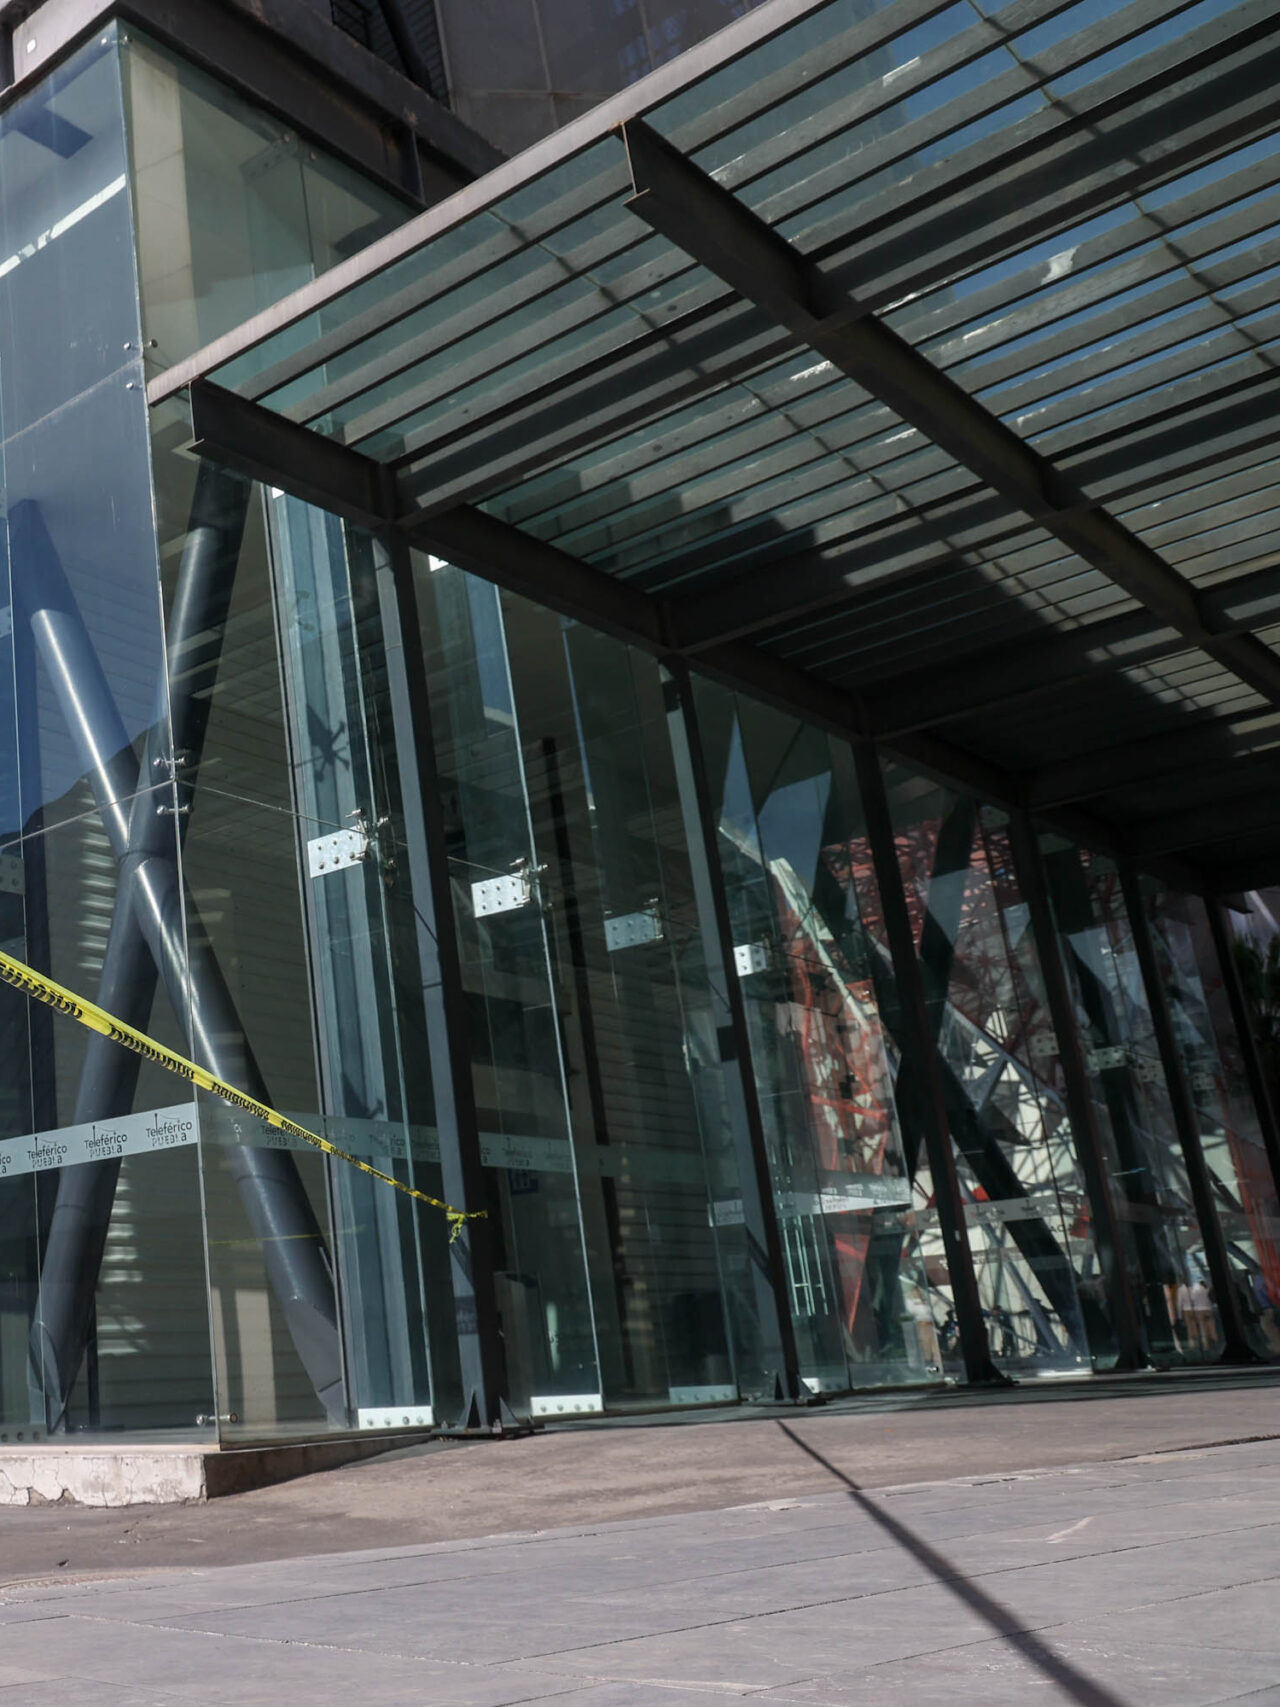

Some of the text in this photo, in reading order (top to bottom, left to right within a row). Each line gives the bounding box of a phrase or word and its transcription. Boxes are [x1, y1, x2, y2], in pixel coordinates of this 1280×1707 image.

[85, 1125, 128, 1149] Teleférico
[146, 1113, 193, 1138] Teleférico
[27, 1137, 67, 1160] Teleférico
